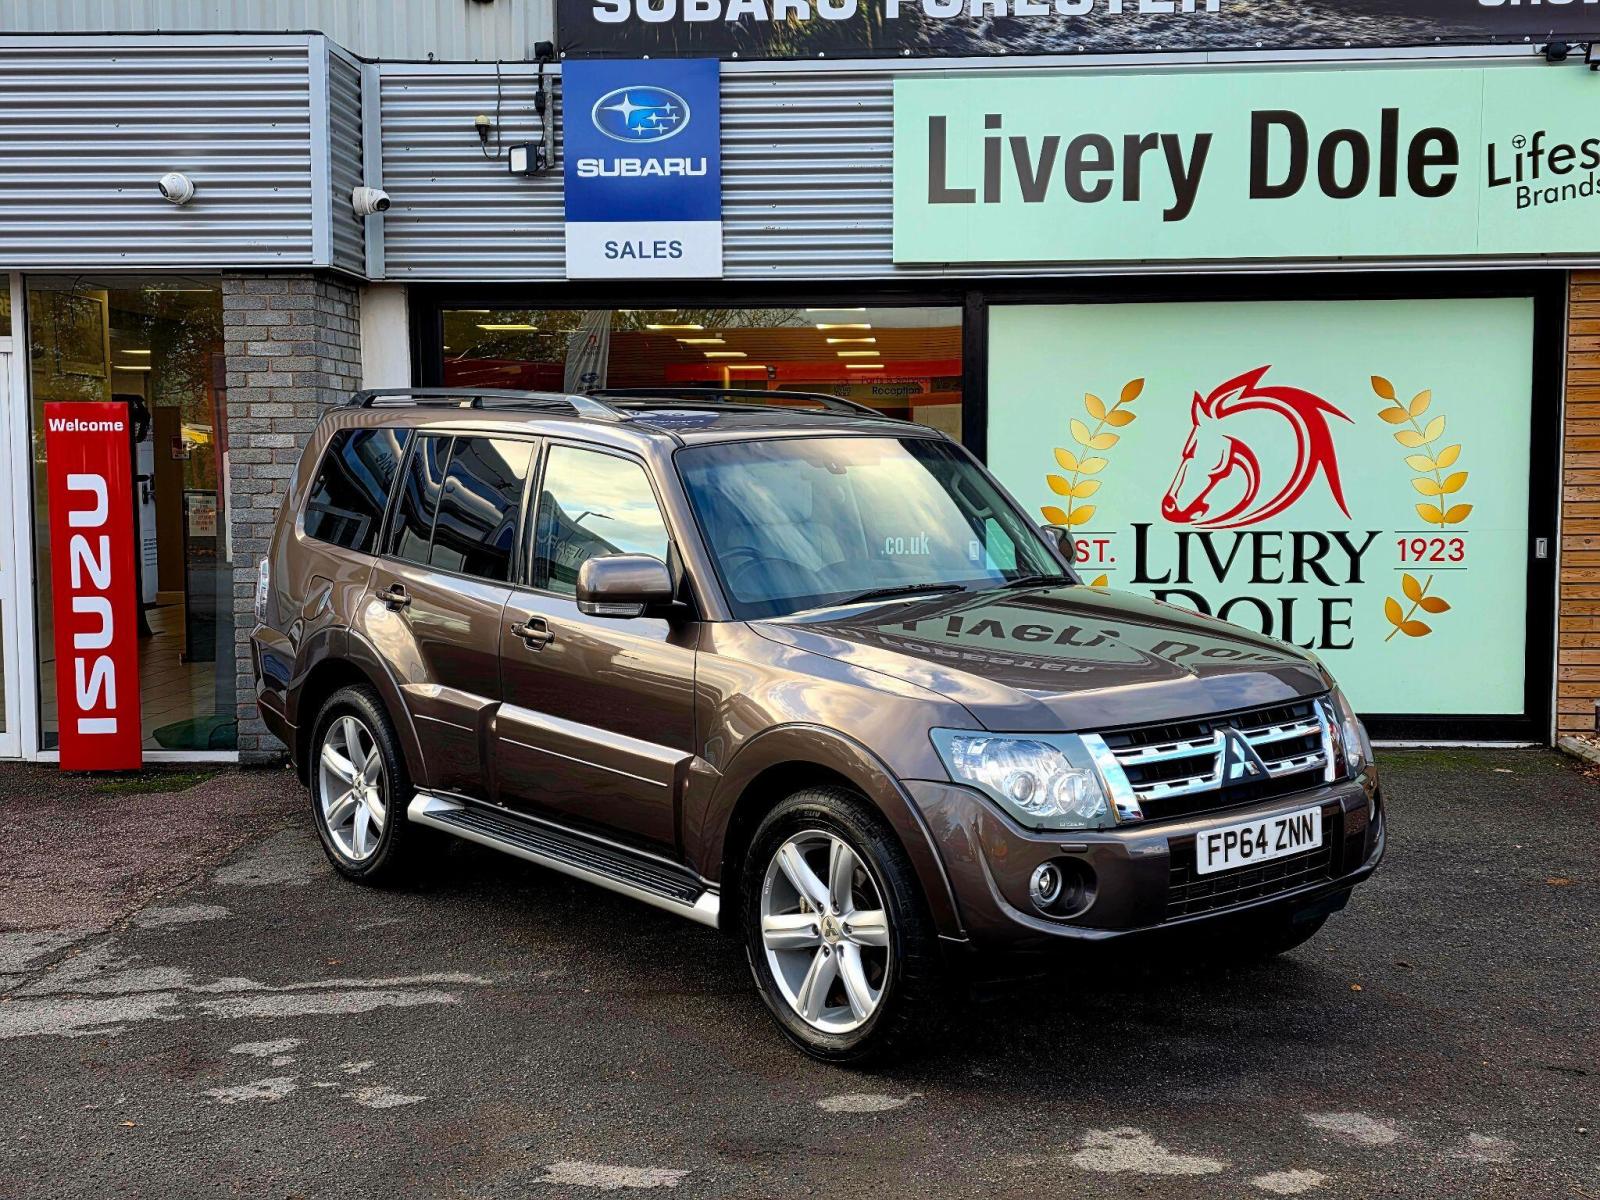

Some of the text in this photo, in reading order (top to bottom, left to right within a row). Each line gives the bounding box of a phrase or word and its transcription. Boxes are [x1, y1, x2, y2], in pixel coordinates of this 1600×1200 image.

[577, 158, 707, 177] SUBARU
[928, 107, 1459, 222] Livery Dole
[605, 240, 683, 259] SALES
[872, 386, 921, 397] Reception
[49, 418, 124, 432] Welcome
[1075, 540, 1117, 563] ST.
[1130, 523, 1383, 586] LIVERY
[1397, 537, 1465, 562] 1923
[67, 474, 117, 734] ISUZU
[1207, 812, 1314, 866] FP64 ZNN
